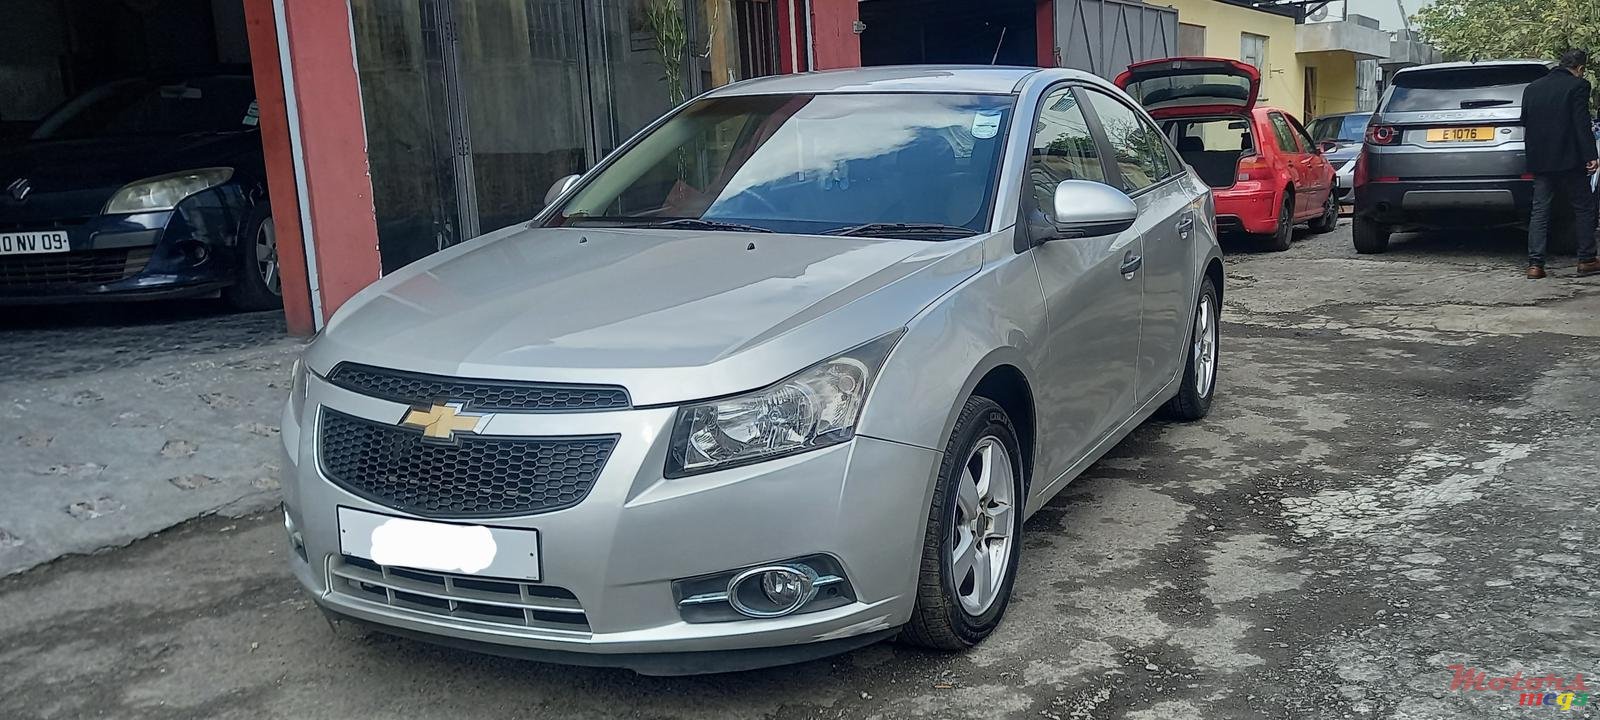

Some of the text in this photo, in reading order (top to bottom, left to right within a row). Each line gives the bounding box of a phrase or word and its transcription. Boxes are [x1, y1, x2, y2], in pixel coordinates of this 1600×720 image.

[1443, 128, 1477, 140] E 1076
[0, 234, 62, 251] 0 NV 09
